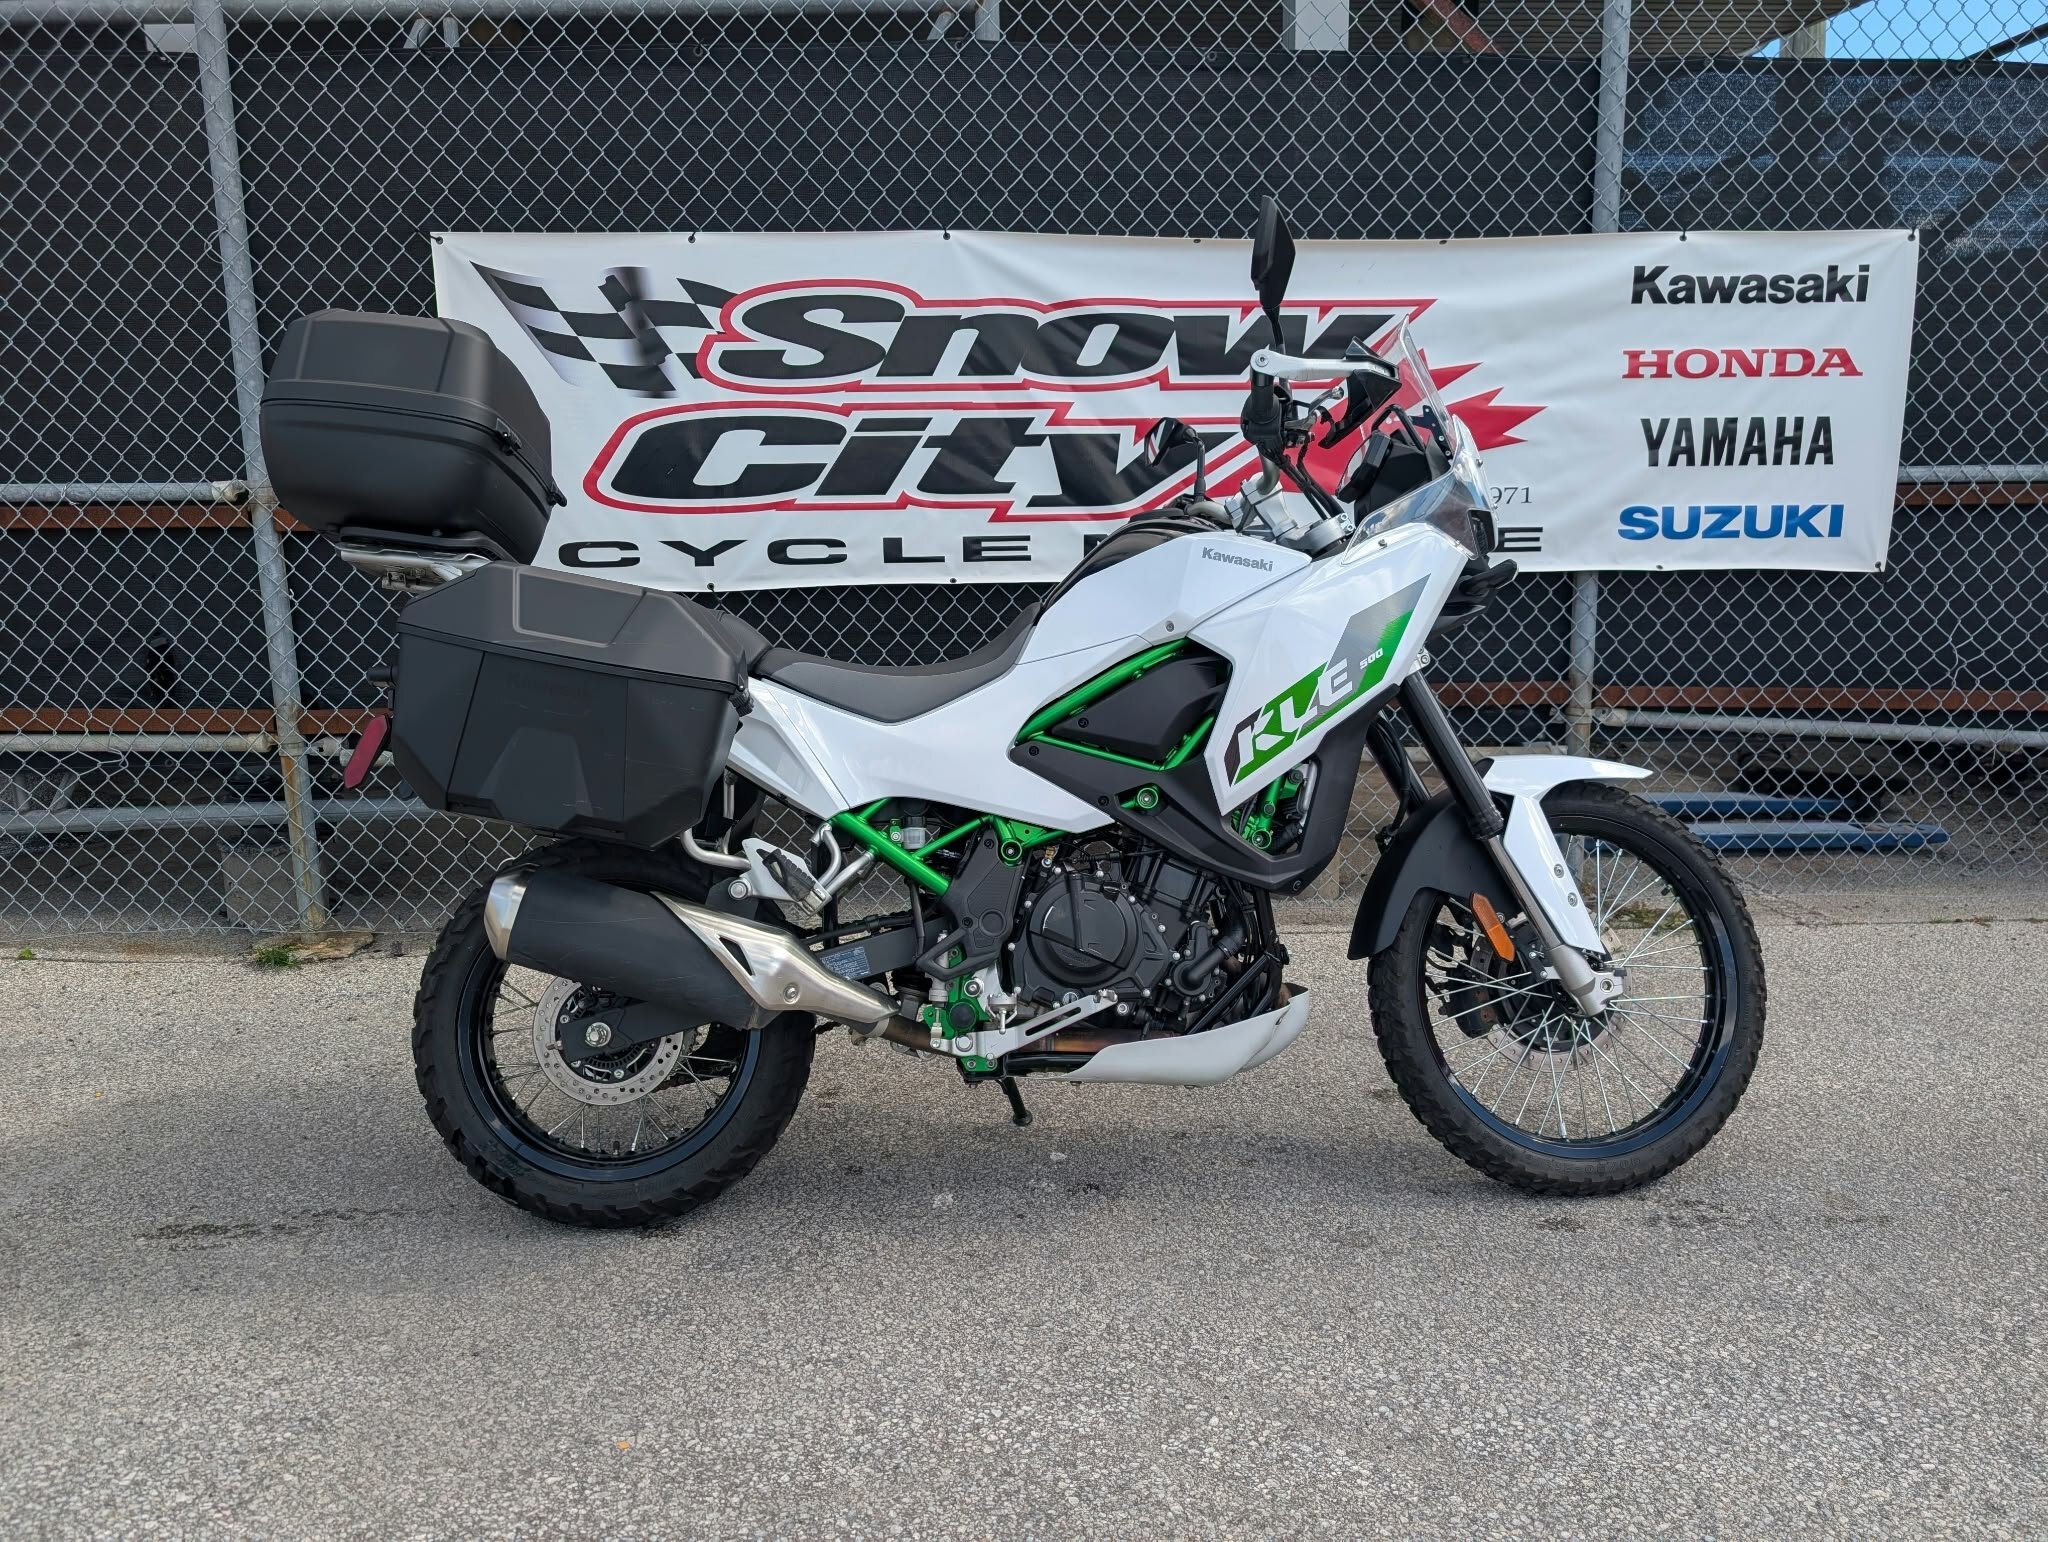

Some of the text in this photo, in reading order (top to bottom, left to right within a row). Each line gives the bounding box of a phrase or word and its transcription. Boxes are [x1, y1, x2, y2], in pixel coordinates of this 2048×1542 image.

[1631, 264, 1870, 304] Kawasaki
[717, 293, 1396, 380] Snow
[1621, 347, 1863, 379] HONDA
[1640, 416, 1834, 467] YAMAHA
[610, 414, 1240, 508] City
[1490, 486, 1533, 505] 971
[1617, 504, 1845, 540] SUZUKI
[558, 534, 1032, 568] CYCLE
[1201, 546, 1274, 572] Kawasaki
[1237, 647, 1384, 767] KLE 500
